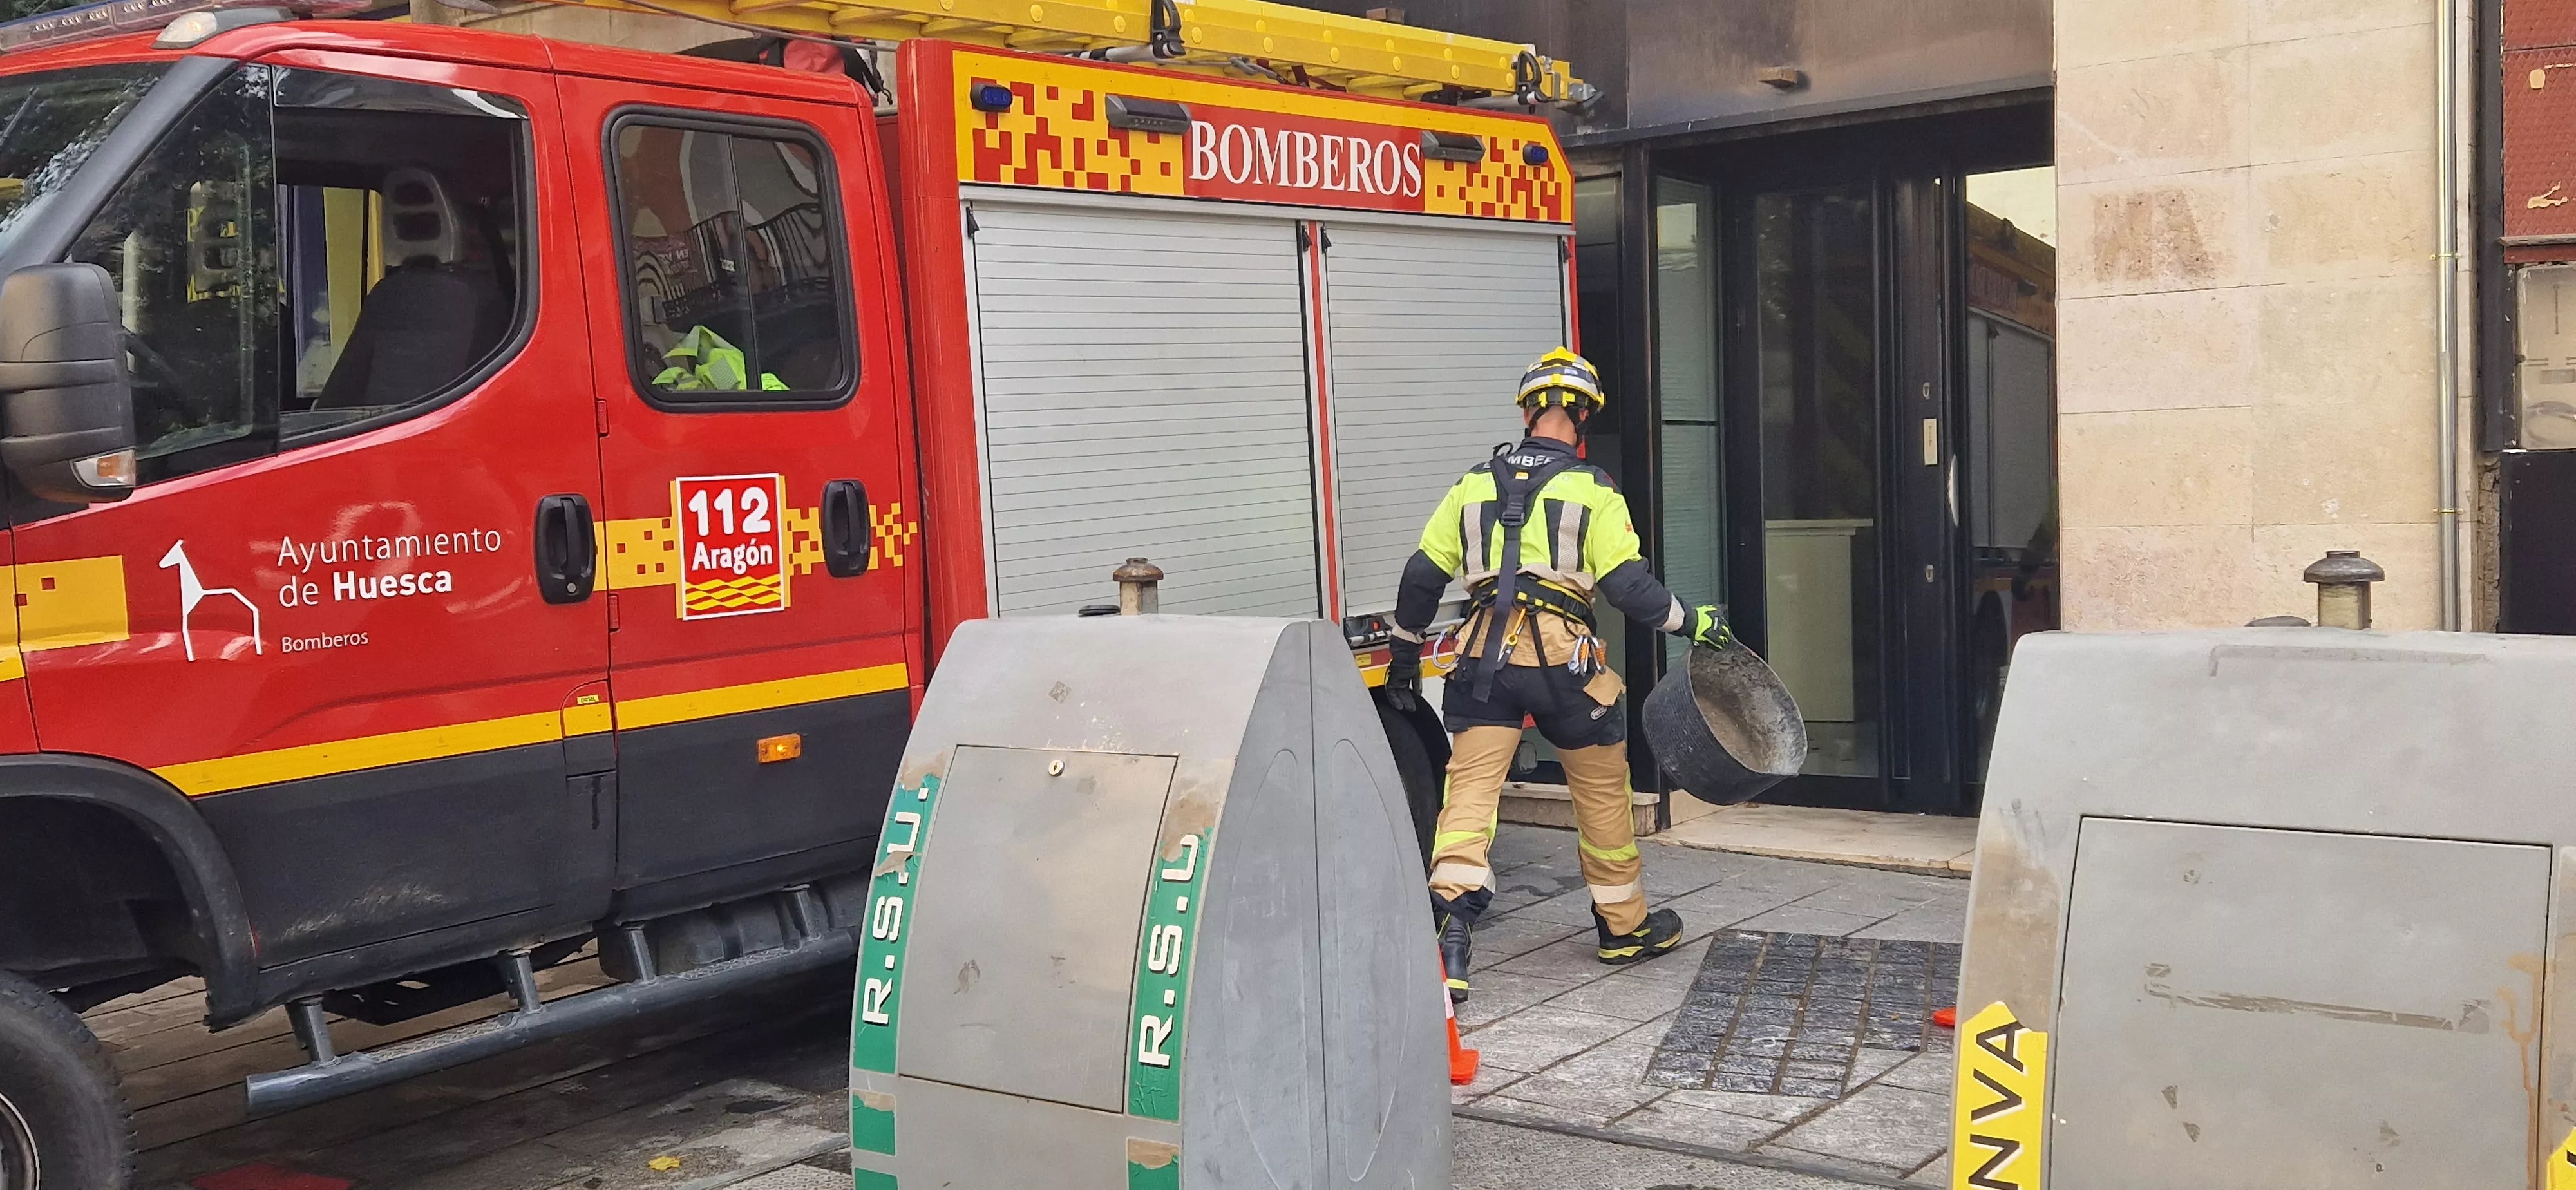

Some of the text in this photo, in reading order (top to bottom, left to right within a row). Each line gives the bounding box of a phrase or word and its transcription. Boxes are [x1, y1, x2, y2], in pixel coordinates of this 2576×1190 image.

[1189, 120, 1422, 198] BOMBEROS
[688, 486, 771, 536] 112
[278, 528, 501, 574] Ayuntamiento
[692, 538, 773, 575] Aragón
[279, 571, 452, 607] de Huesca
[281, 632, 369, 653] Bomberos
